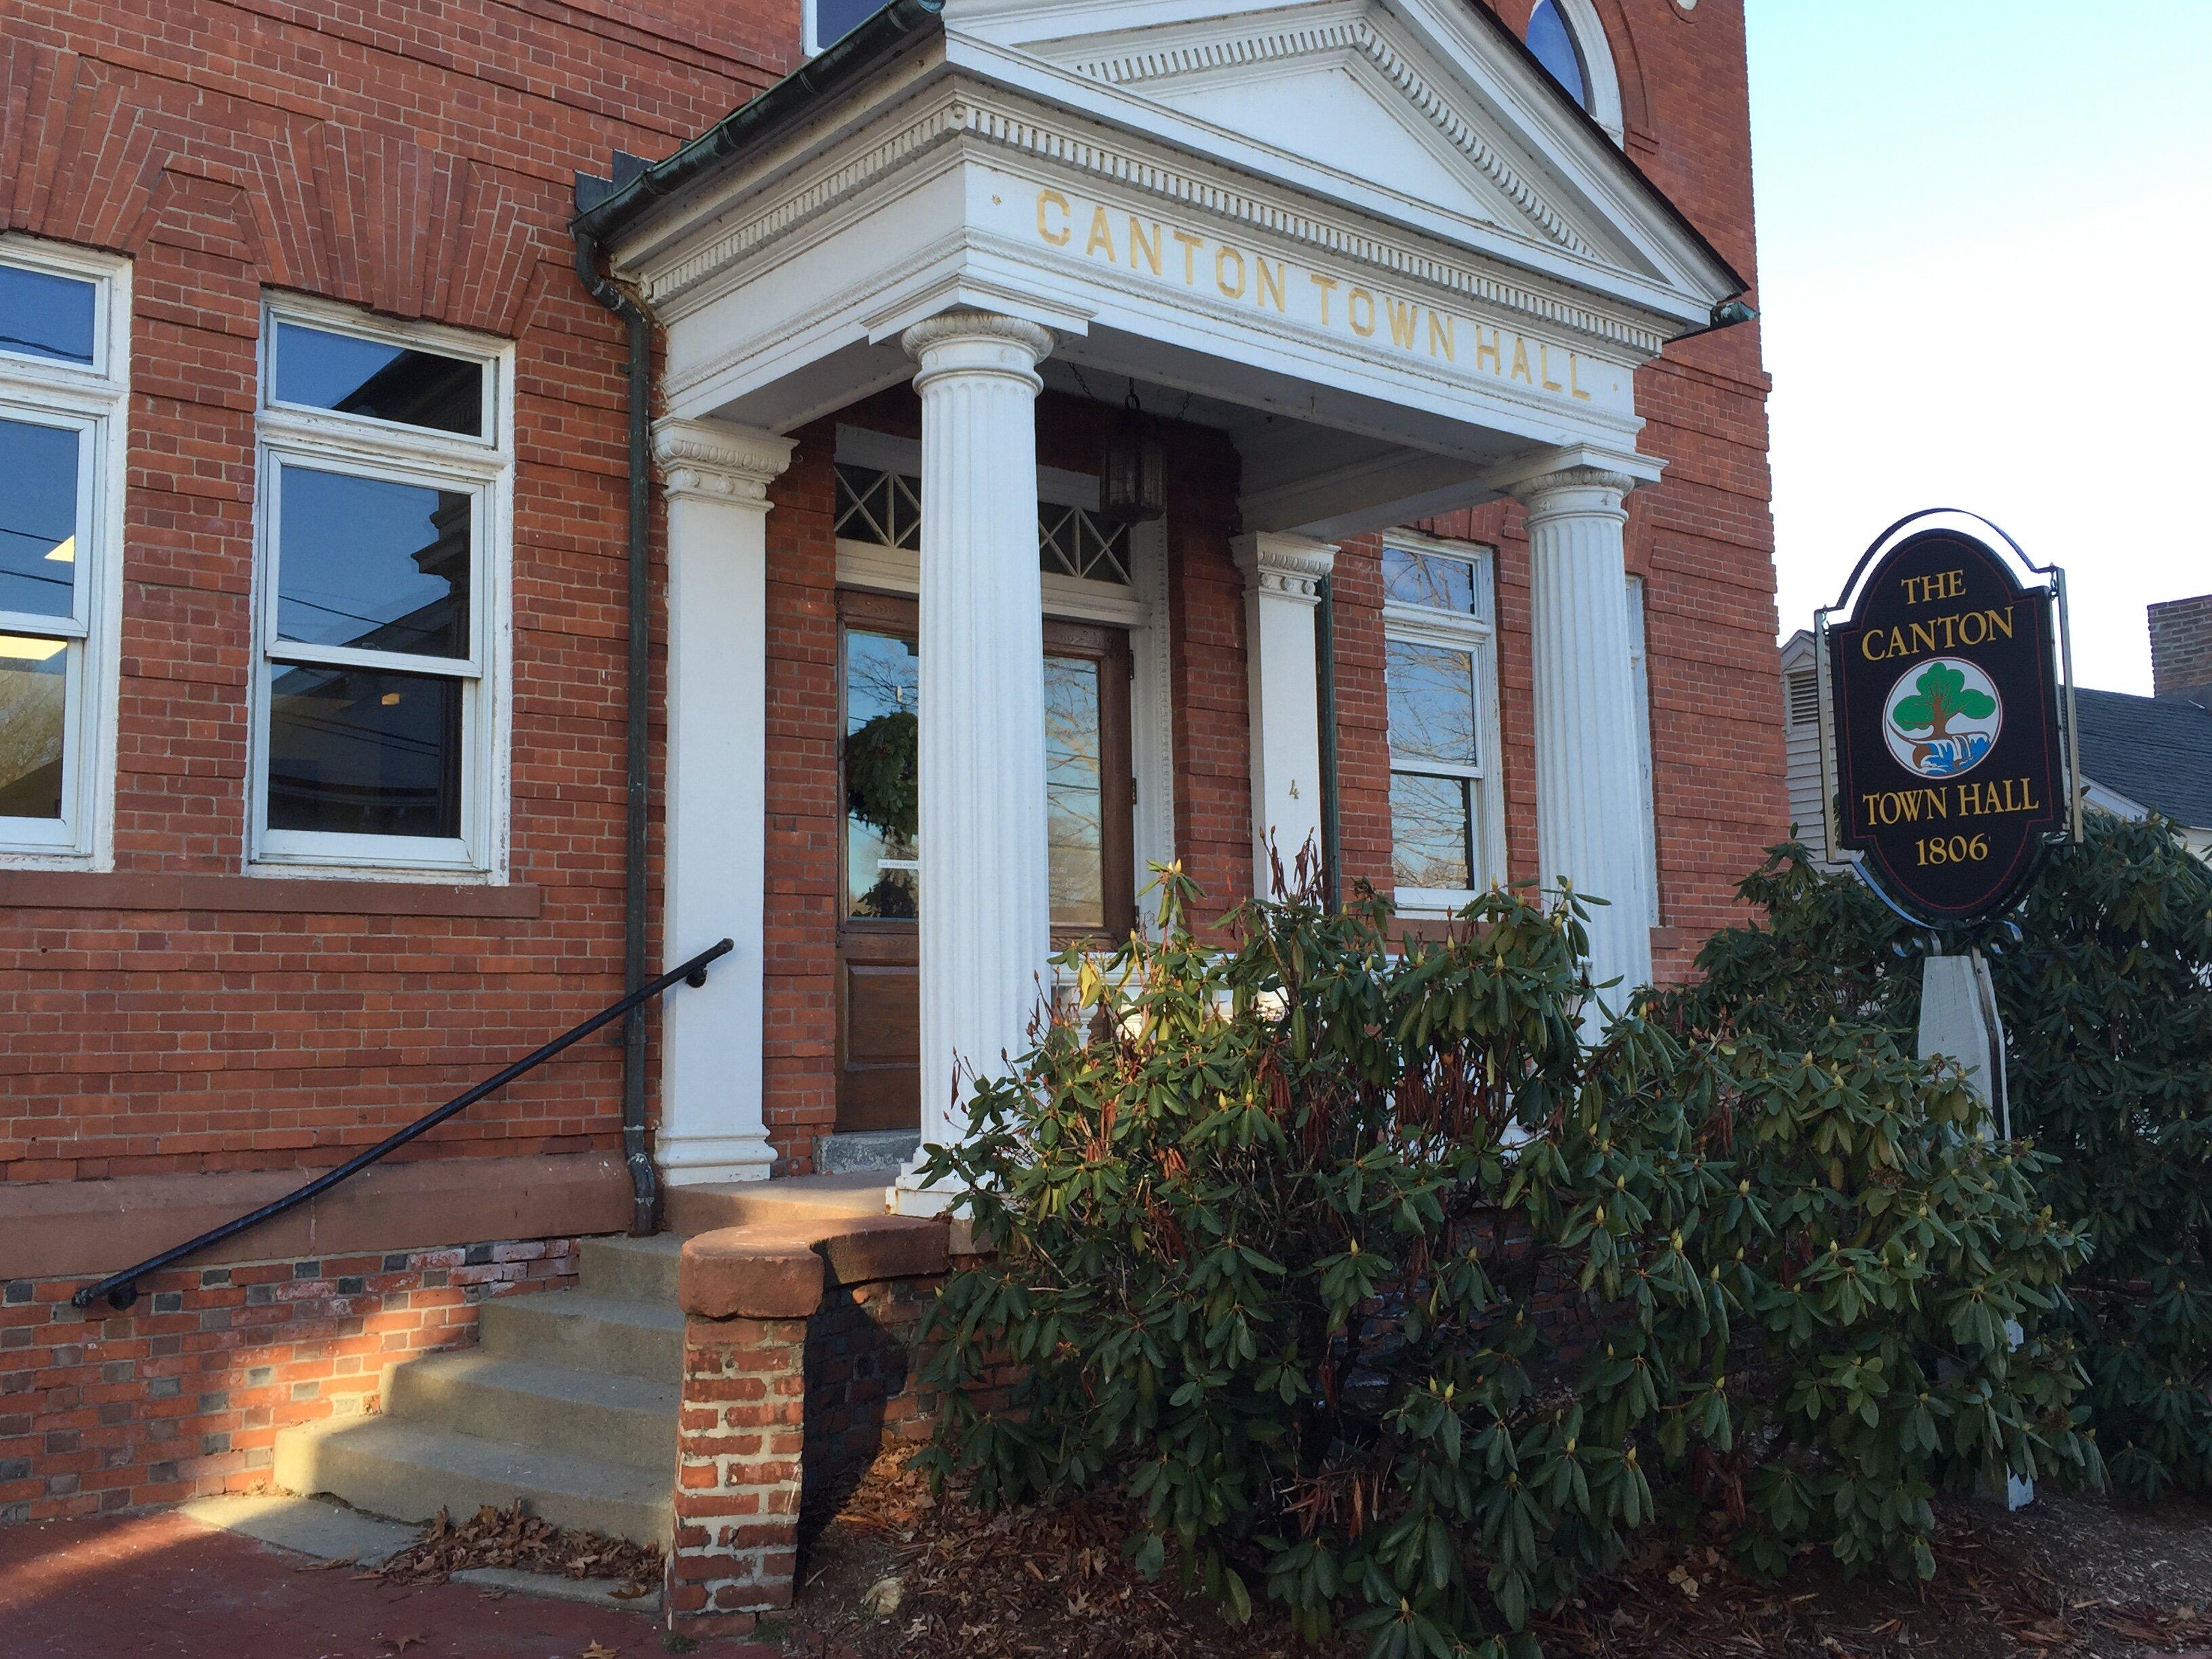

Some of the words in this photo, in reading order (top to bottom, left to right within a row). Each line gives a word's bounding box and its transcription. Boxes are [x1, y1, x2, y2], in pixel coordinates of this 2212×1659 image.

[1038, 189, 1285, 312] CANTON
[1311, 274, 1454, 361] TOWN
[1477, 325, 1592, 400] HALL
[1901, 570, 1967, 605] THE
[1862, 607, 2013, 661] CANTON
[1289, 779, 1299, 799] 4
[1863, 787, 1948, 826] TOWN
[1957, 777, 2040, 817] HALL
[1915, 834, 1988, 866] 1806
